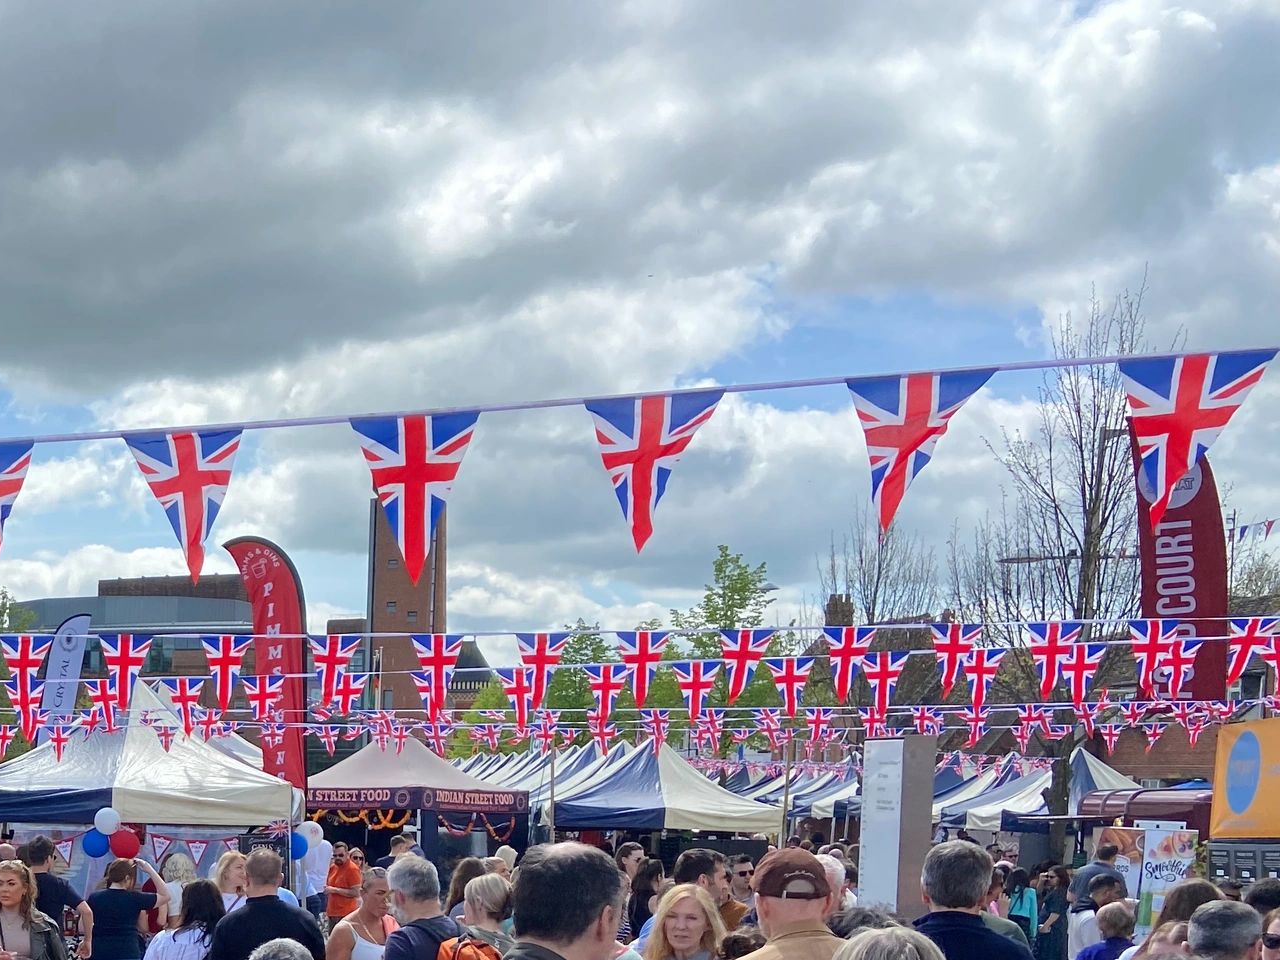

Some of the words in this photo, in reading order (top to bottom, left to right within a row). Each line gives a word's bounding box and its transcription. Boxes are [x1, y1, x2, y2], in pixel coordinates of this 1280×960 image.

[242, 551, 255, 580] PIMMS
[263, 549, 280, 568] GINS
[53, 659, 71, 708] CRYTAL
[315, 789, 359, 801] STREET
[360, 789, 391, 801] FOOD
[436, 790, 464, 804] INDIAN
[465, 792, 493, 805] STREET
[495, 793, 515, 805] FOOD
